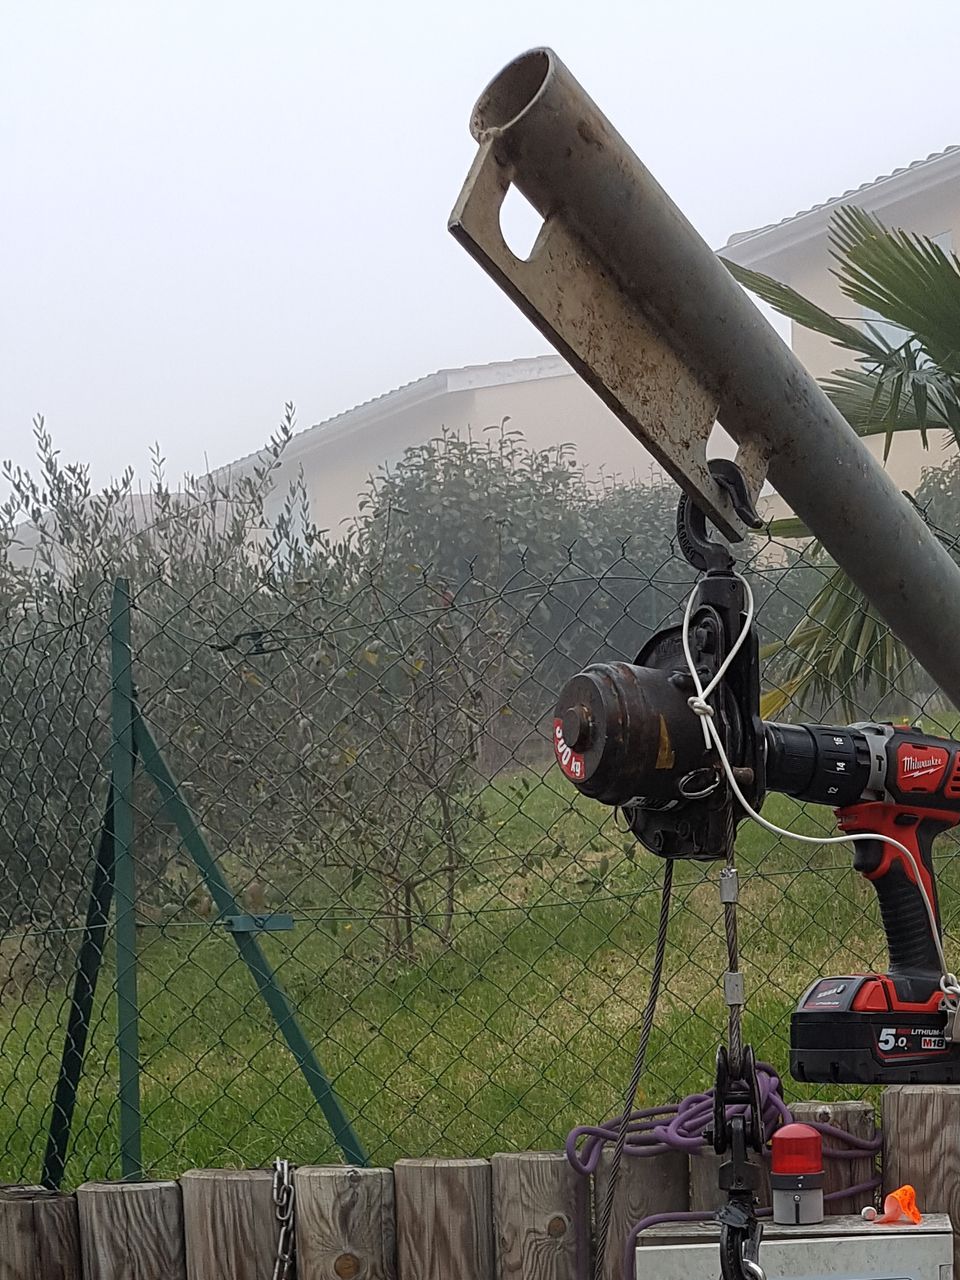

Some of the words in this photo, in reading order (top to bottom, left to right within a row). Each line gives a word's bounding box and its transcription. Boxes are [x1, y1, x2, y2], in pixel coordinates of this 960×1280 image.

[836, 762, 846, 771] 14
[902, 756, 942, 772] Milwaukee
[923, 1038, 945, 1049] M18
